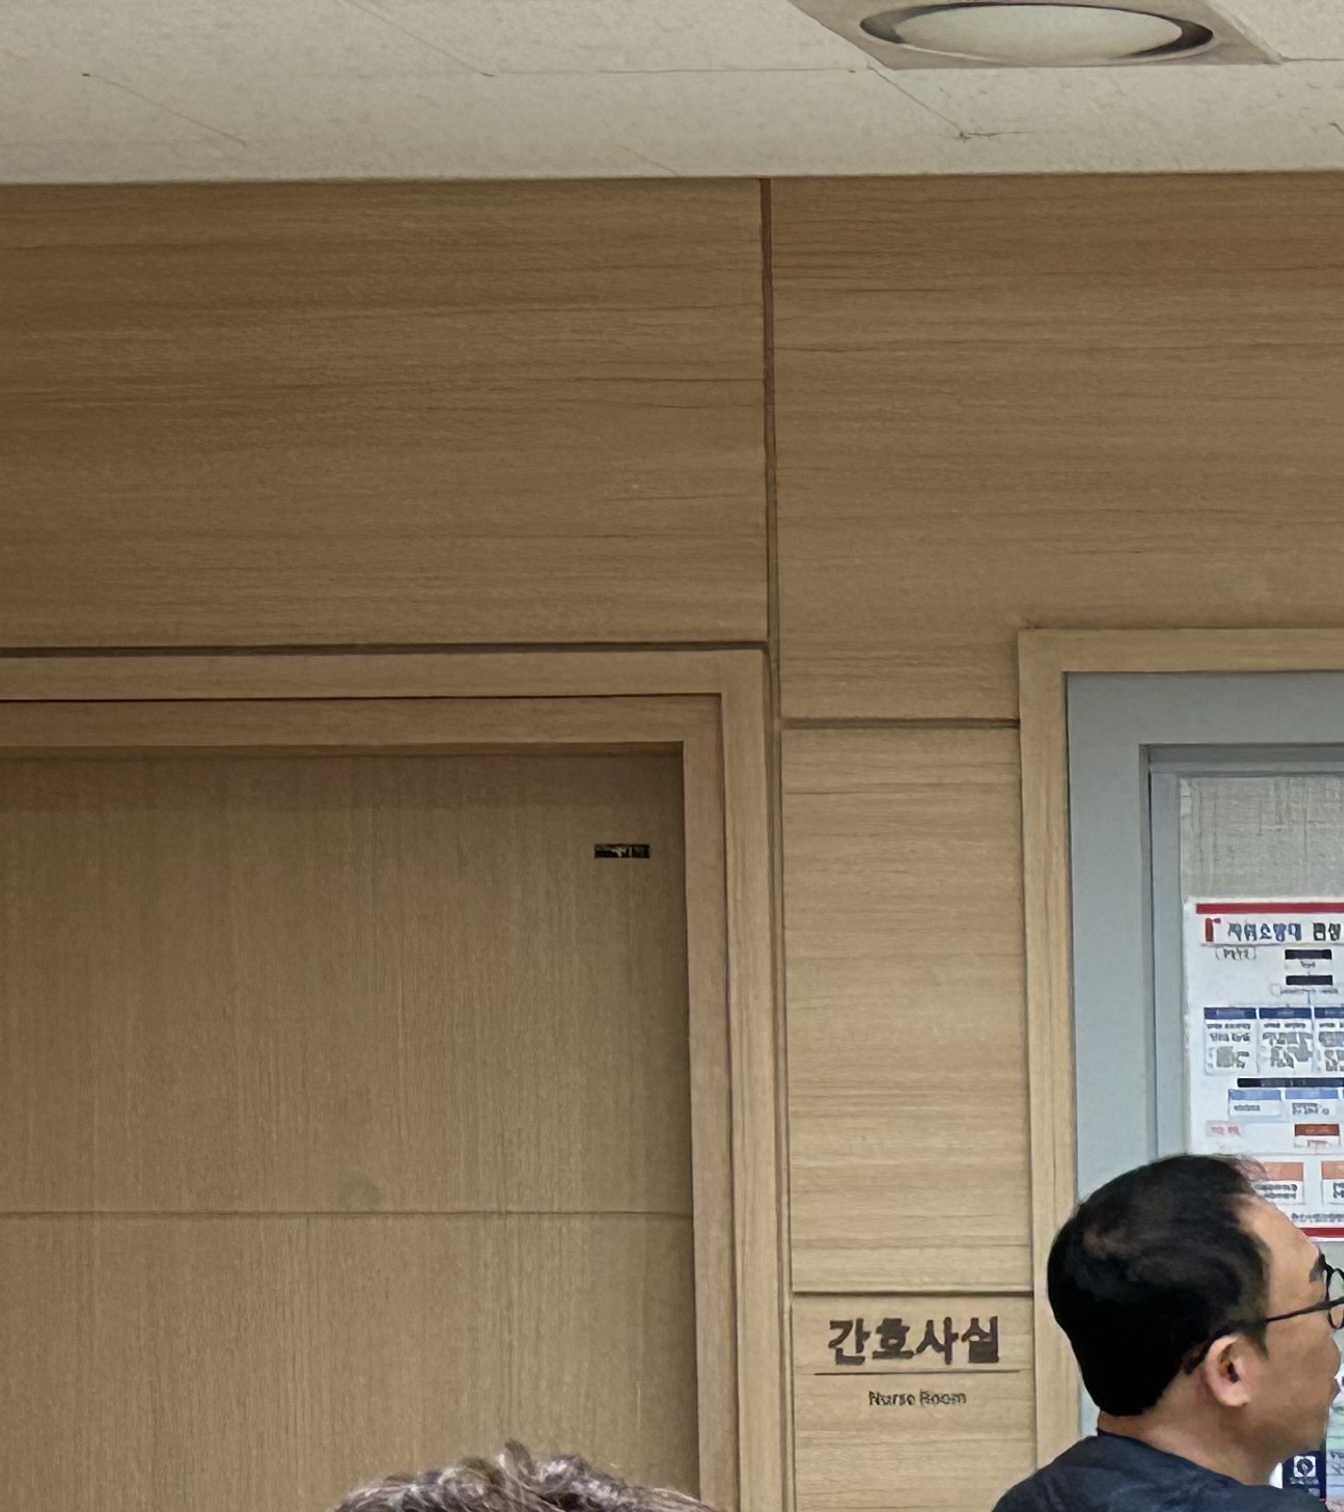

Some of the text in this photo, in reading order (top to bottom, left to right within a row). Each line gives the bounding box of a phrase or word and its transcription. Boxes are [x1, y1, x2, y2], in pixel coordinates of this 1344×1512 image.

[827, 1315, 1000, 1366] 간호사실
[868, 1389, 967, 1406] Nurse Room
